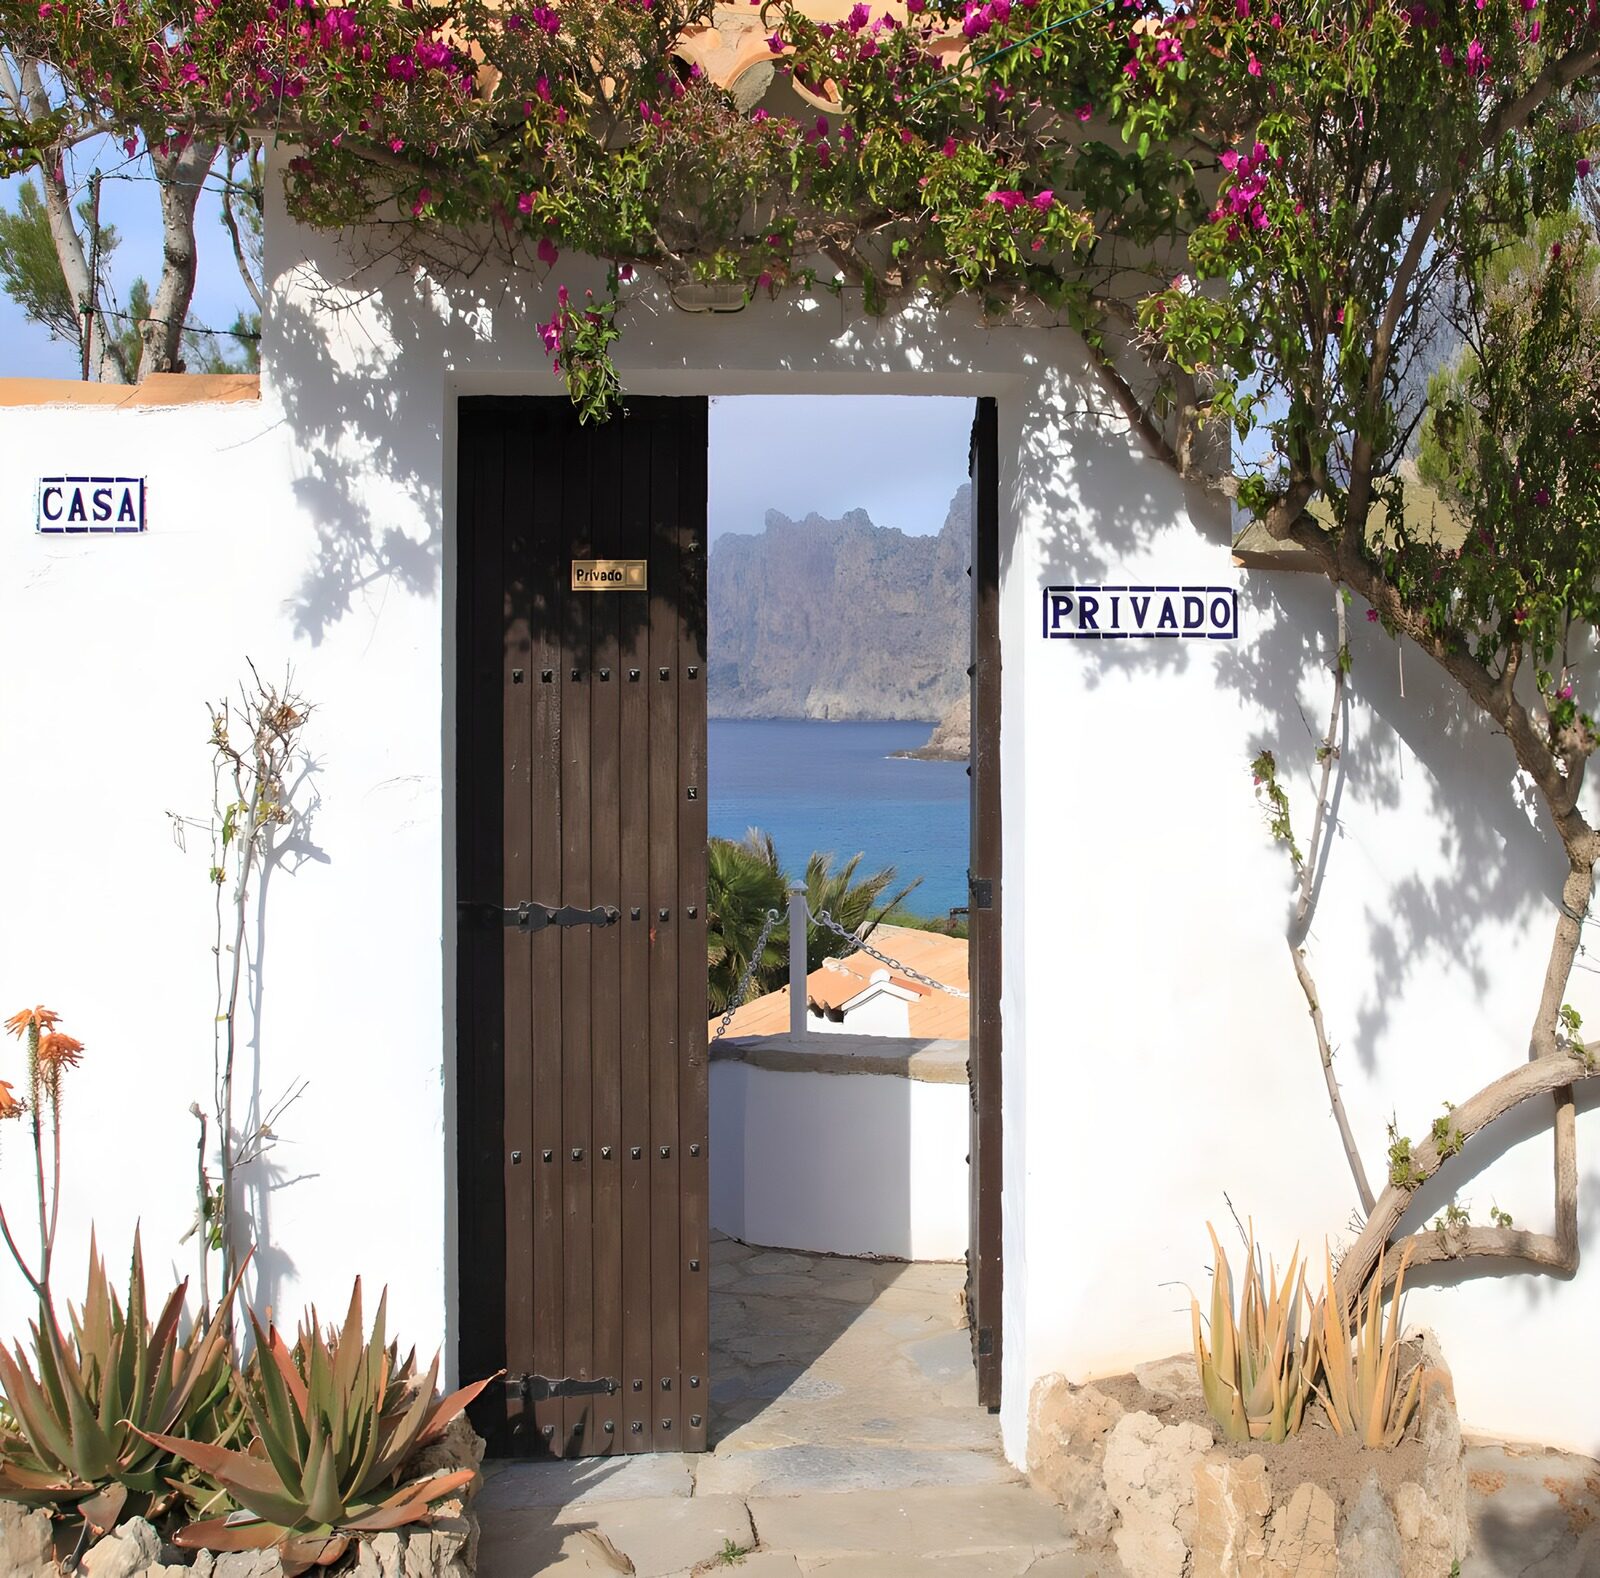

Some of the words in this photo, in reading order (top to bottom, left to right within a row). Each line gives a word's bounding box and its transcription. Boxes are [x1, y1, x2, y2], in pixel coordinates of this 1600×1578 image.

[42, 487, 136, 522] CASA
[576, 568, 623, 582] Privado
[1050, 595, 1231, 629] PRIVADO
